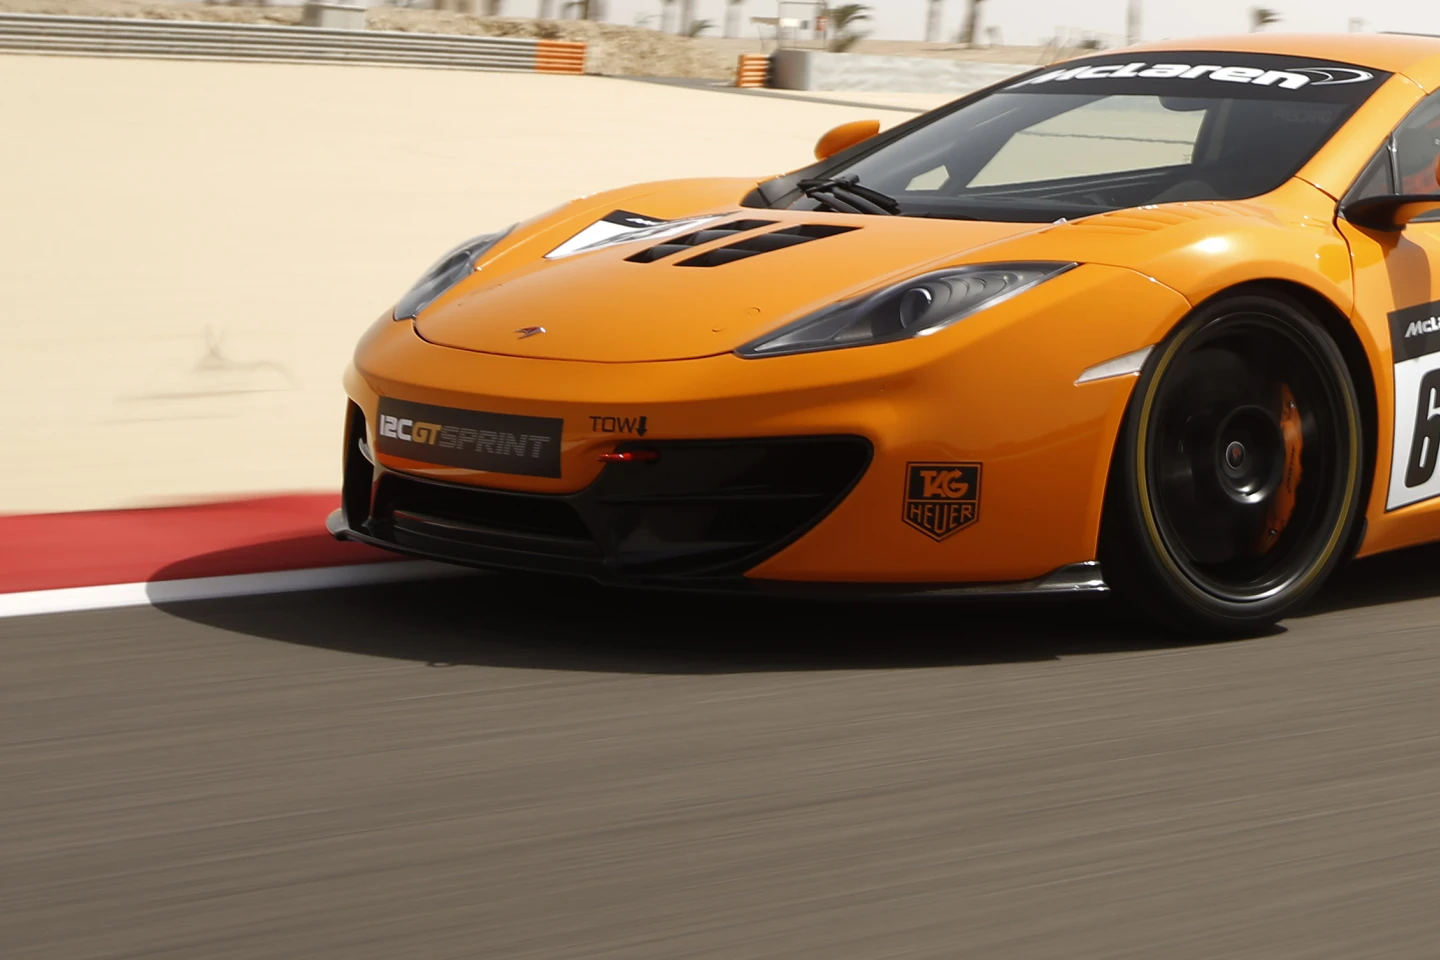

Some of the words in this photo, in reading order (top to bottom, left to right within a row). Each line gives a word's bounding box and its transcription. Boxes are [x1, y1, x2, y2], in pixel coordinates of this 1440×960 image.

[1003, 62, 1311, 90] McLaren
[589, 415, 637, 433] TOW
[920, 468, 969, 498] TAG
[910, 504, 972, 533] HEUER
